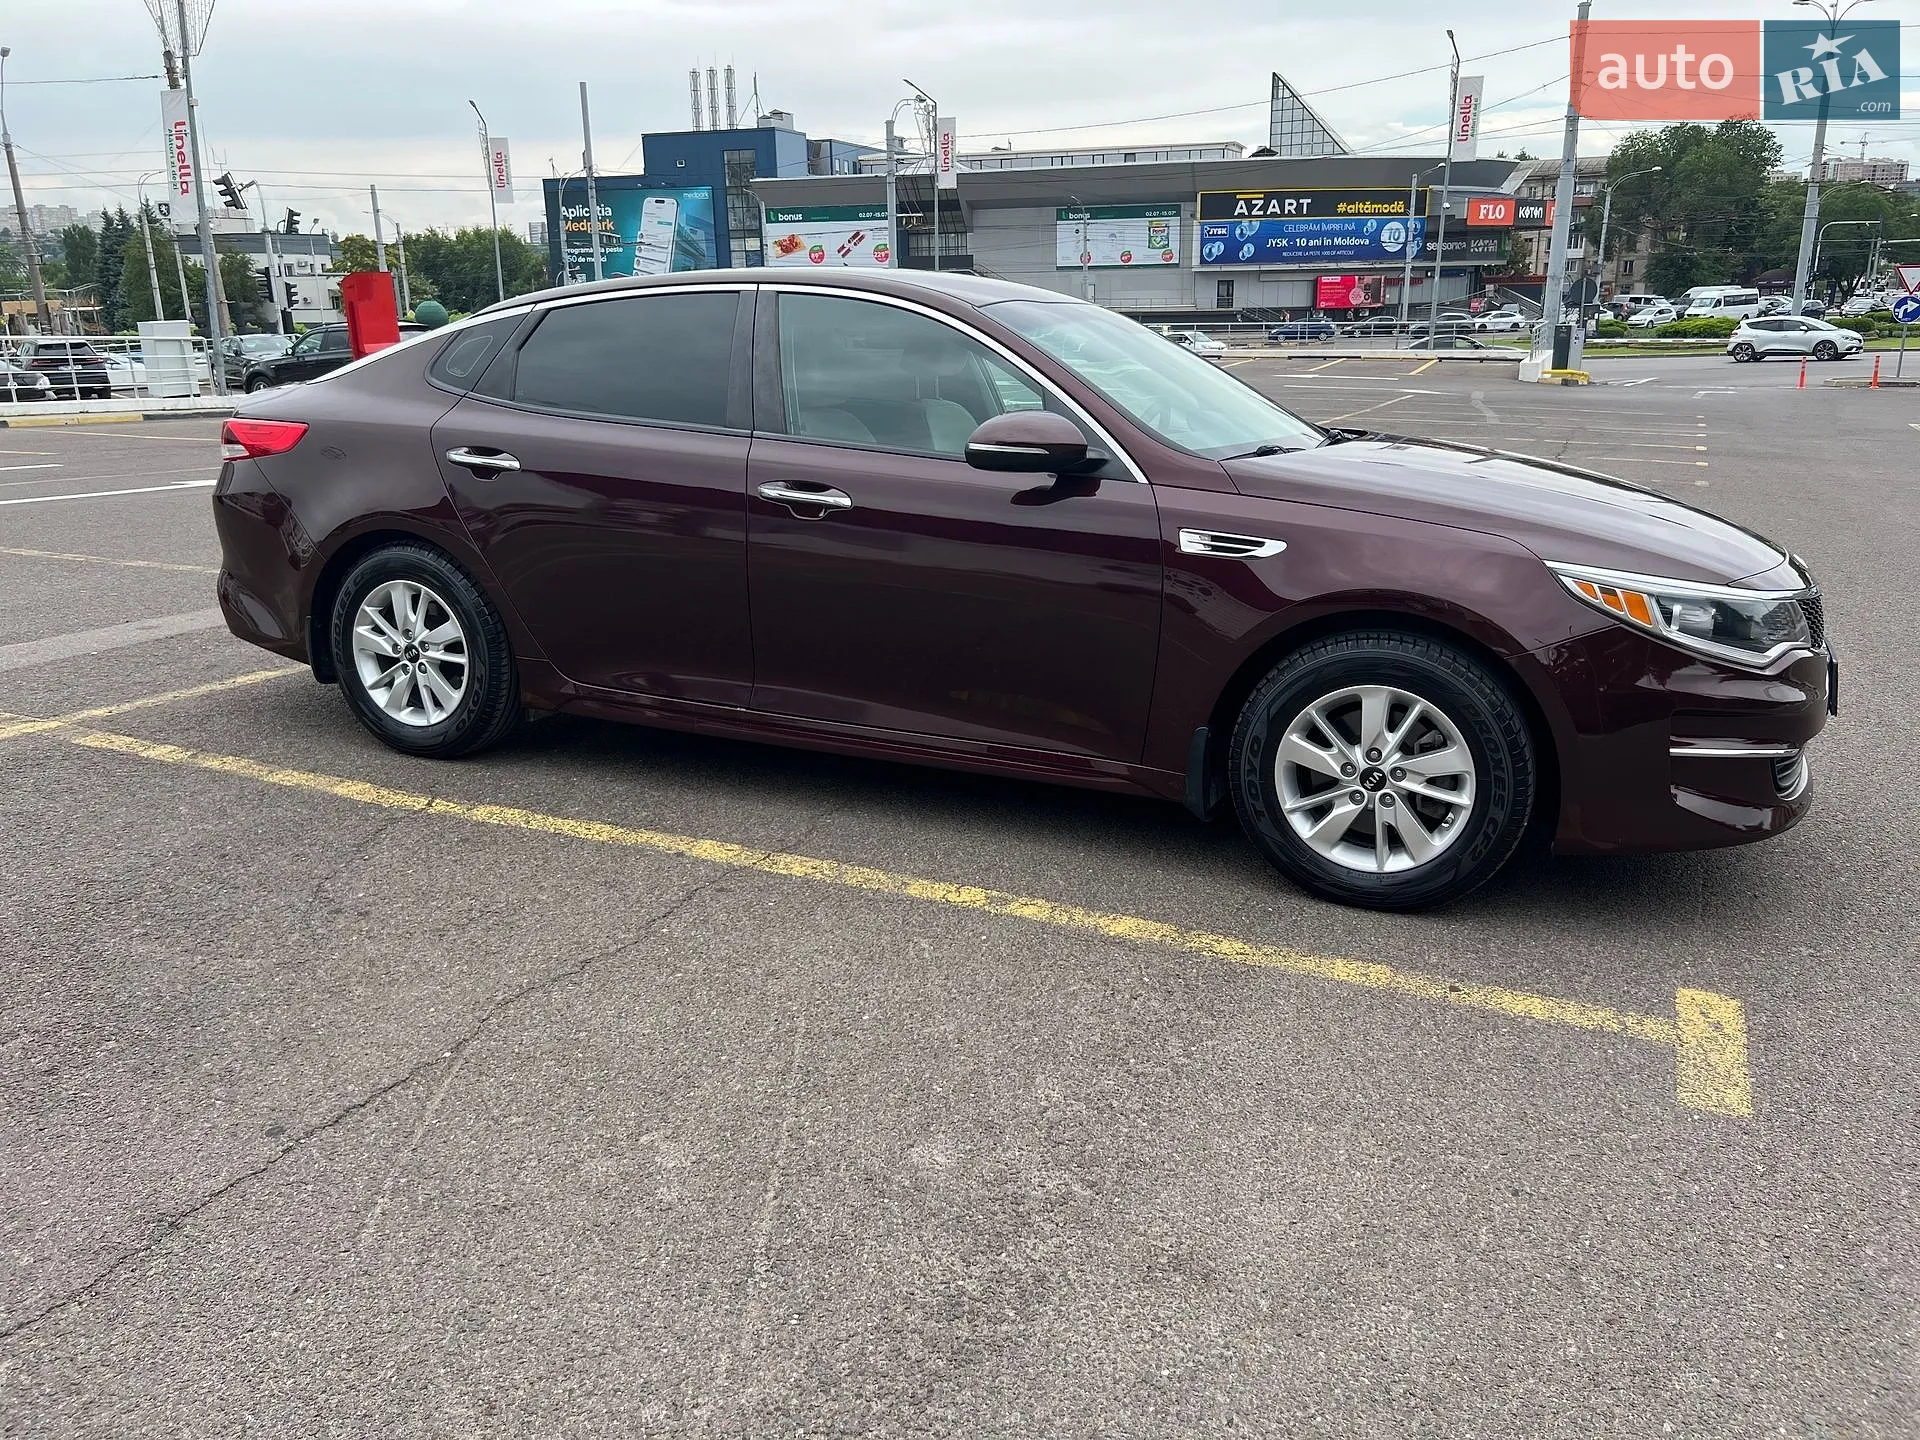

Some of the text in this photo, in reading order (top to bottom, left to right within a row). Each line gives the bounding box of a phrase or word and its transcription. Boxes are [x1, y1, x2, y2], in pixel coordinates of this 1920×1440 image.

[1457, 94, 1473, 142] linella
[174, 120, 192, 196] linella
[941, 132, 950, 173] linella
[494, 151, 506, 188] linella
[561, 203, 613, 220] Aplicția
[1233, 198, 1406, 216] AZART #altămodă
[1479, 204, 1506, 220] FLO
[778, 213, 803, 221] bonus
[1208, 227, 1228, 235] JYSK
[1387, 229, 1401, 241] 10
[1266, 238, 1288, 248] JYSK
[1296, 238, 1307, 247] 10
[1308, 237, 1322, 247] ani
[1333, 236, 1370, 246] Moldova
[1426, 241, 1467, 251] sesonica
[1363, 771, 1383, 790] KIA
